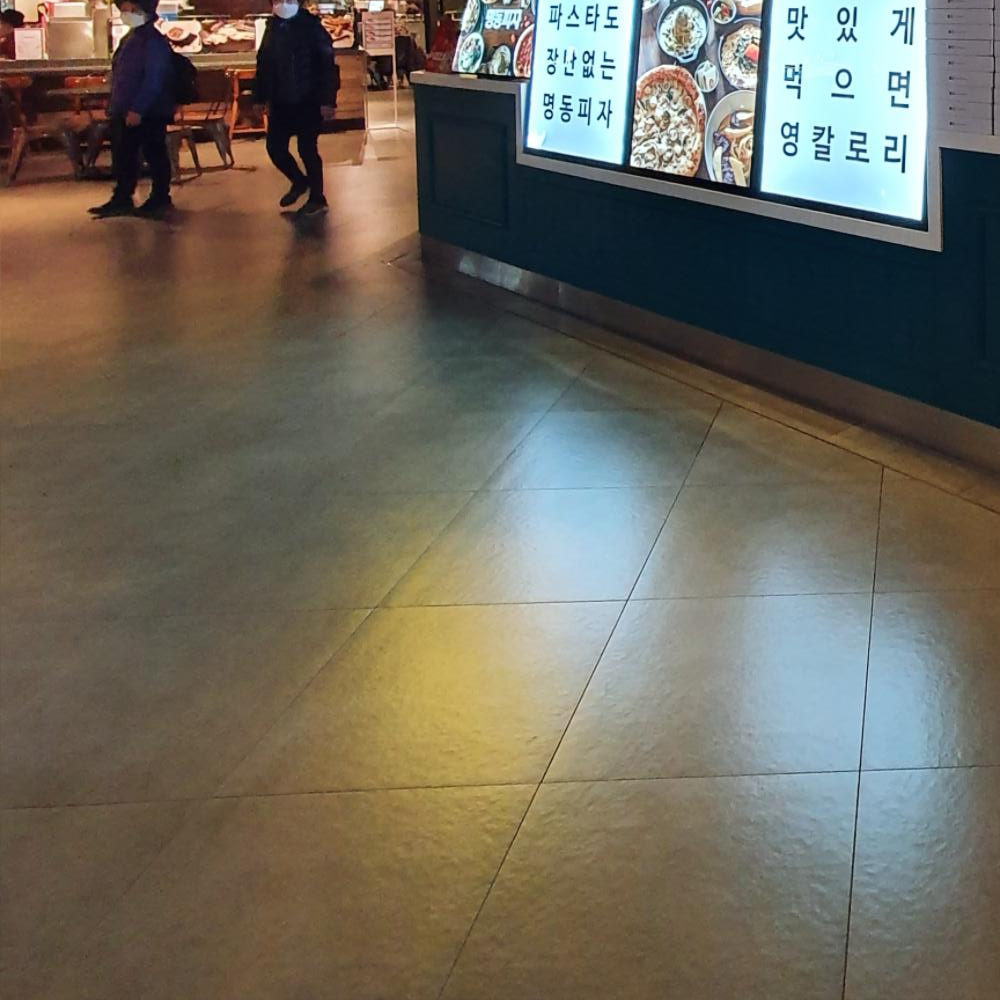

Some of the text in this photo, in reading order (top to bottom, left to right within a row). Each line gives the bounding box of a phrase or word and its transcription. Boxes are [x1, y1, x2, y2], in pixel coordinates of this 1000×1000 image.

[548, 3, 619, 32] 파스타도
[546, 48, 616, 80] 장난없는
[543, 92, 613, 128] 명동피자
[780, 121, 907, 174] 영칼로리
